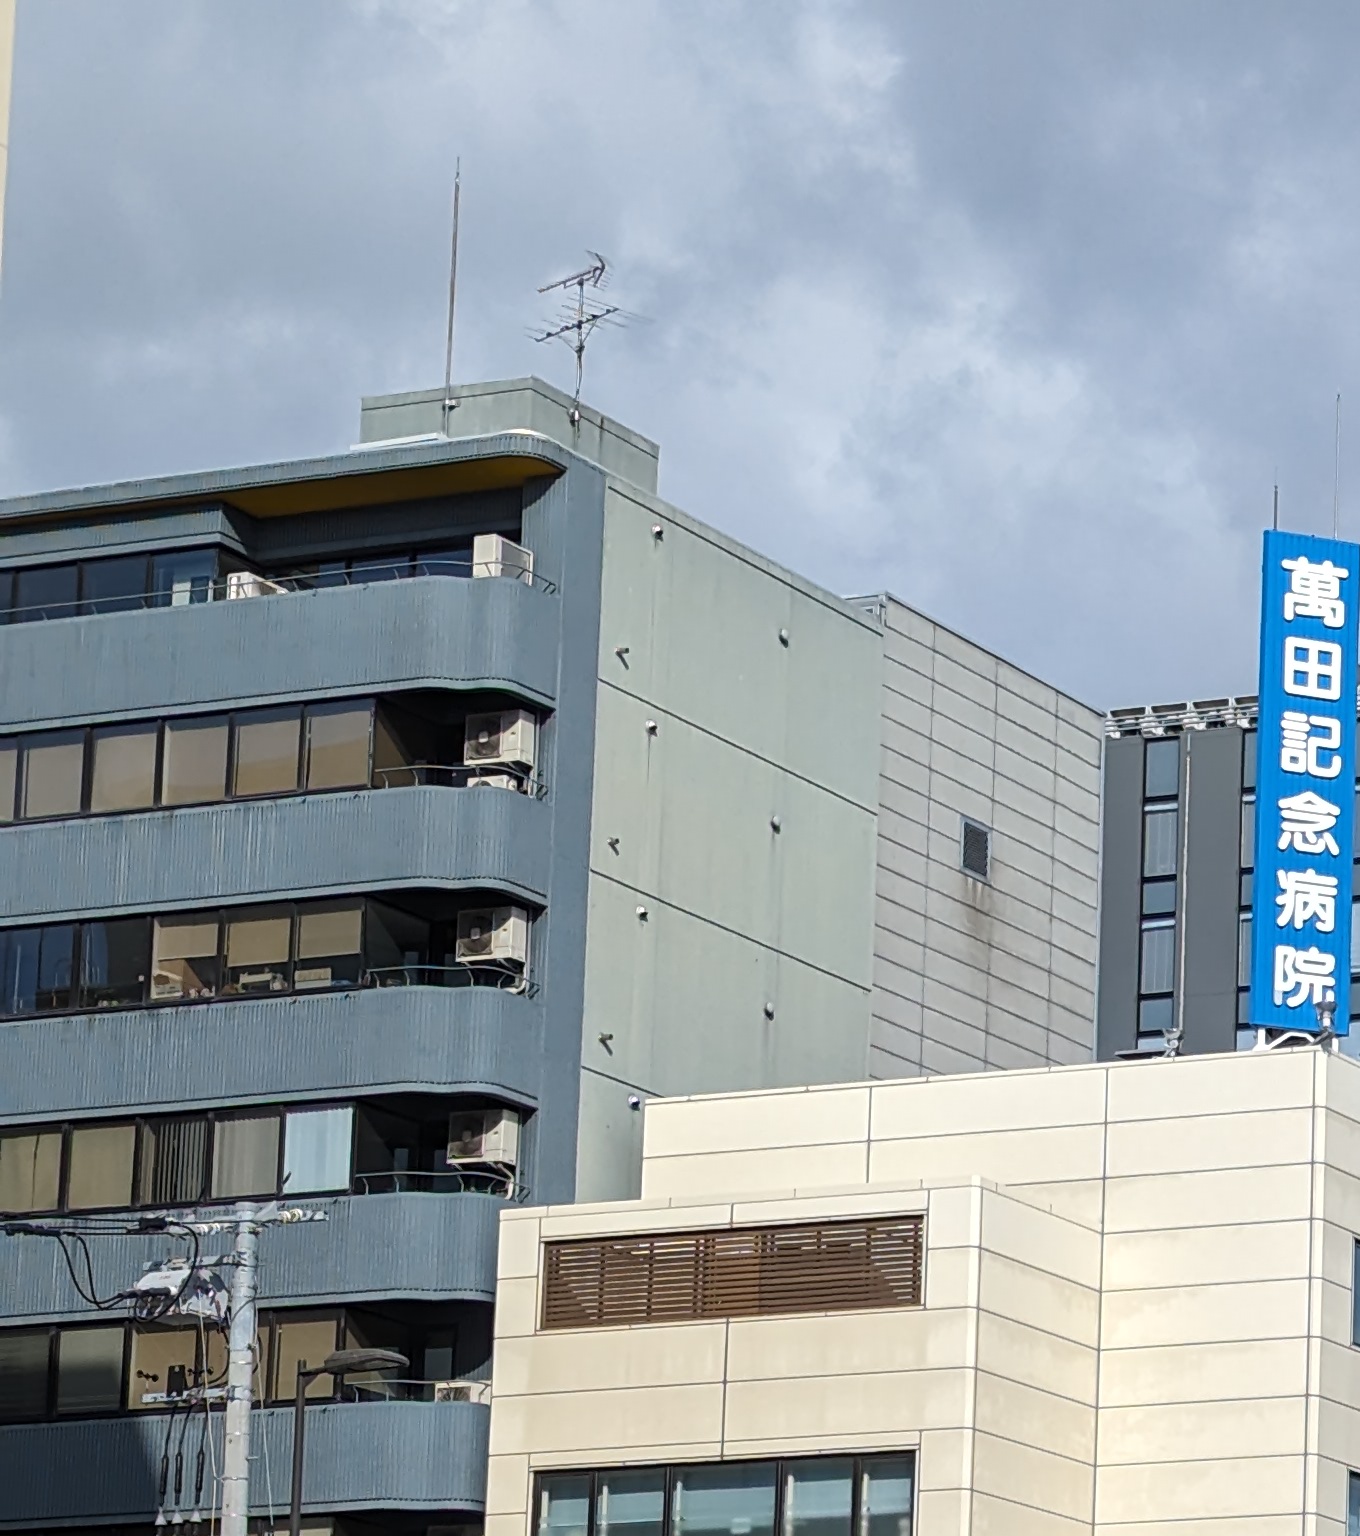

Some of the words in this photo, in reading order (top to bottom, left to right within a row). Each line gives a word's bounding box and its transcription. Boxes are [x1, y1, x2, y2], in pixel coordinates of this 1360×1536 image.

[1274, 555, 1349, 1008] 萬田記念病院
